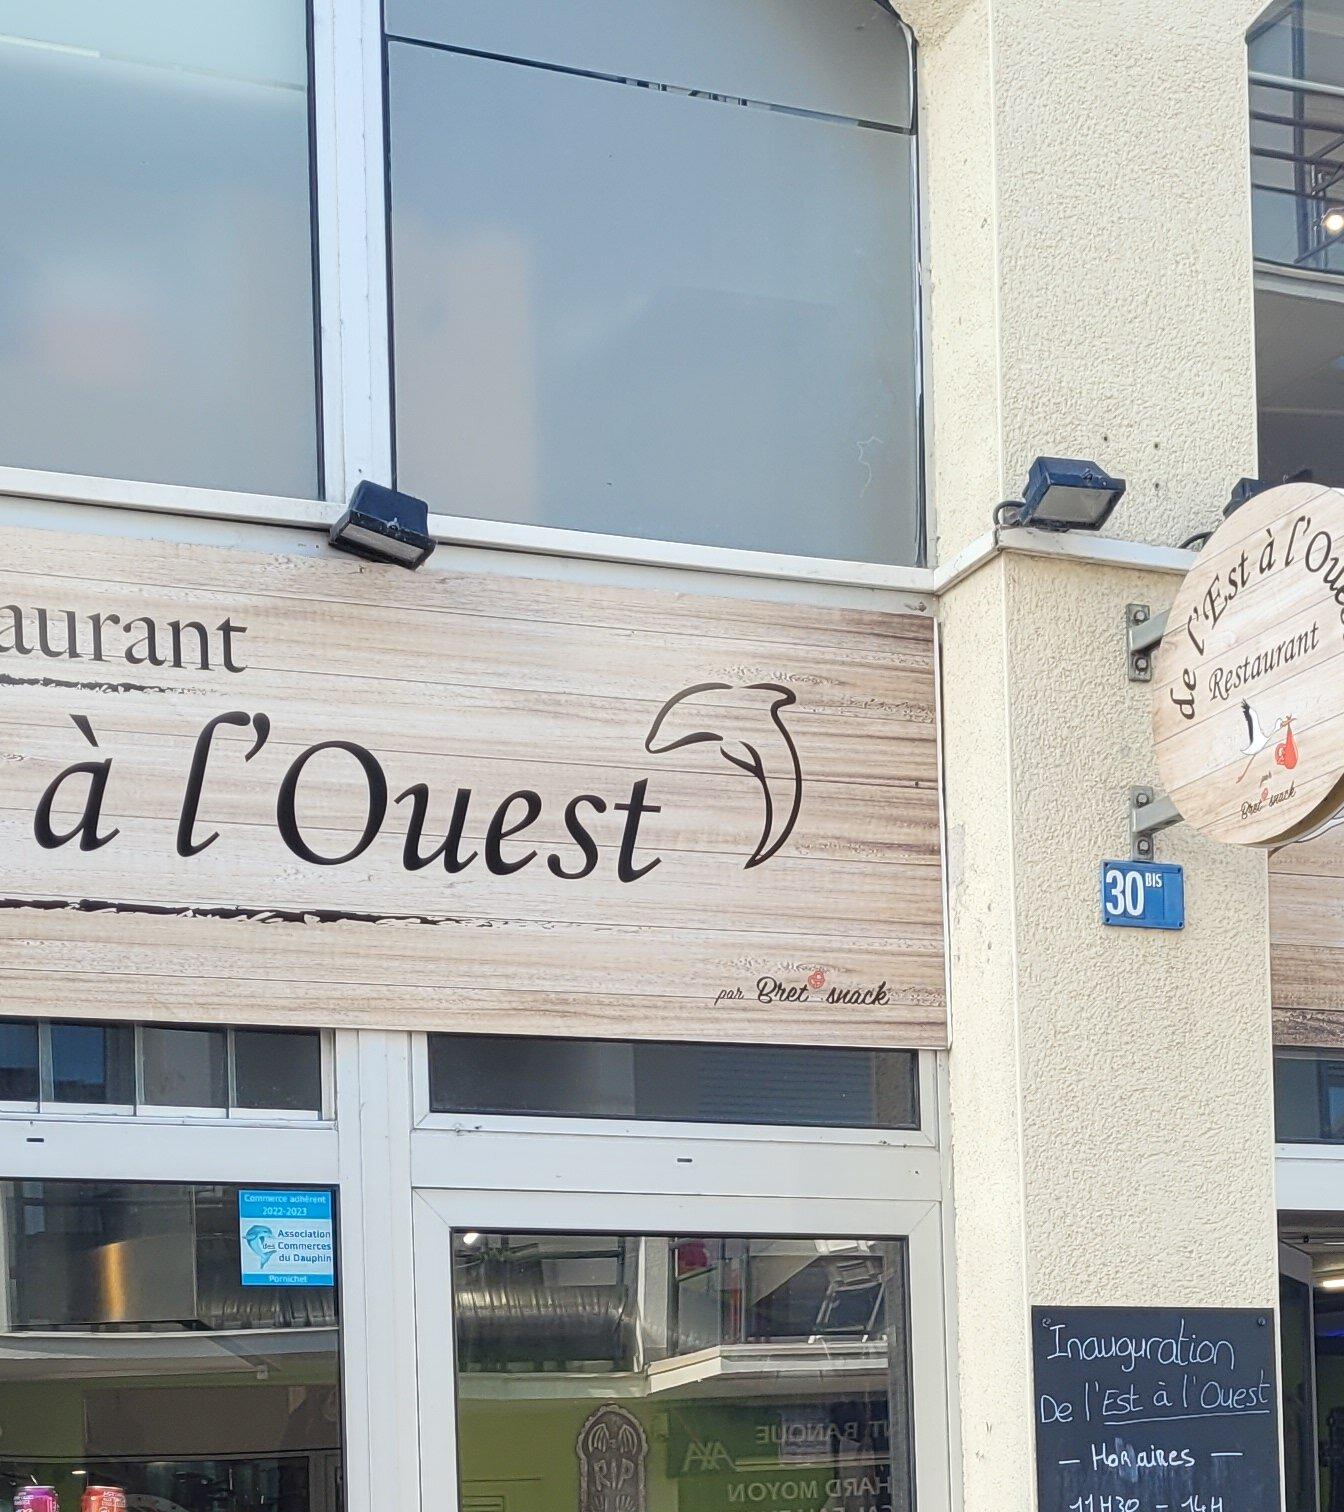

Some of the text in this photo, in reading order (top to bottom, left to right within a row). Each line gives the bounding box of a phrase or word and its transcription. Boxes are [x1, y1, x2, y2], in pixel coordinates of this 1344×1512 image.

[1170, 668, 1196, 720] de
[1259, 528, 1276, 574] à
[1209, 621, 1319, 701] Restaurant
[35, 715, 120, 852] à
[1106, 869, 1163, 917] 30 BIS
[714, 986, 745, 1006] par
[244, 1194, 287, 1204] Commerce
[262, 1206, 307, 1216] 2022-2023
[277, 1229, 331, 1239] Association
[277, 1241, 332, 1251] Commerces
[278, 1253, 332, 1264] du Dauphin
[268, 1274, 309, 1284] Pornichet
[1047, 1319, 1235, 1371] Inauguration
[1040, 1394, 1073, 1423] De
[1154, 1382, 1169, 1408] à
[593, 1459, 633, 1491] RIP
